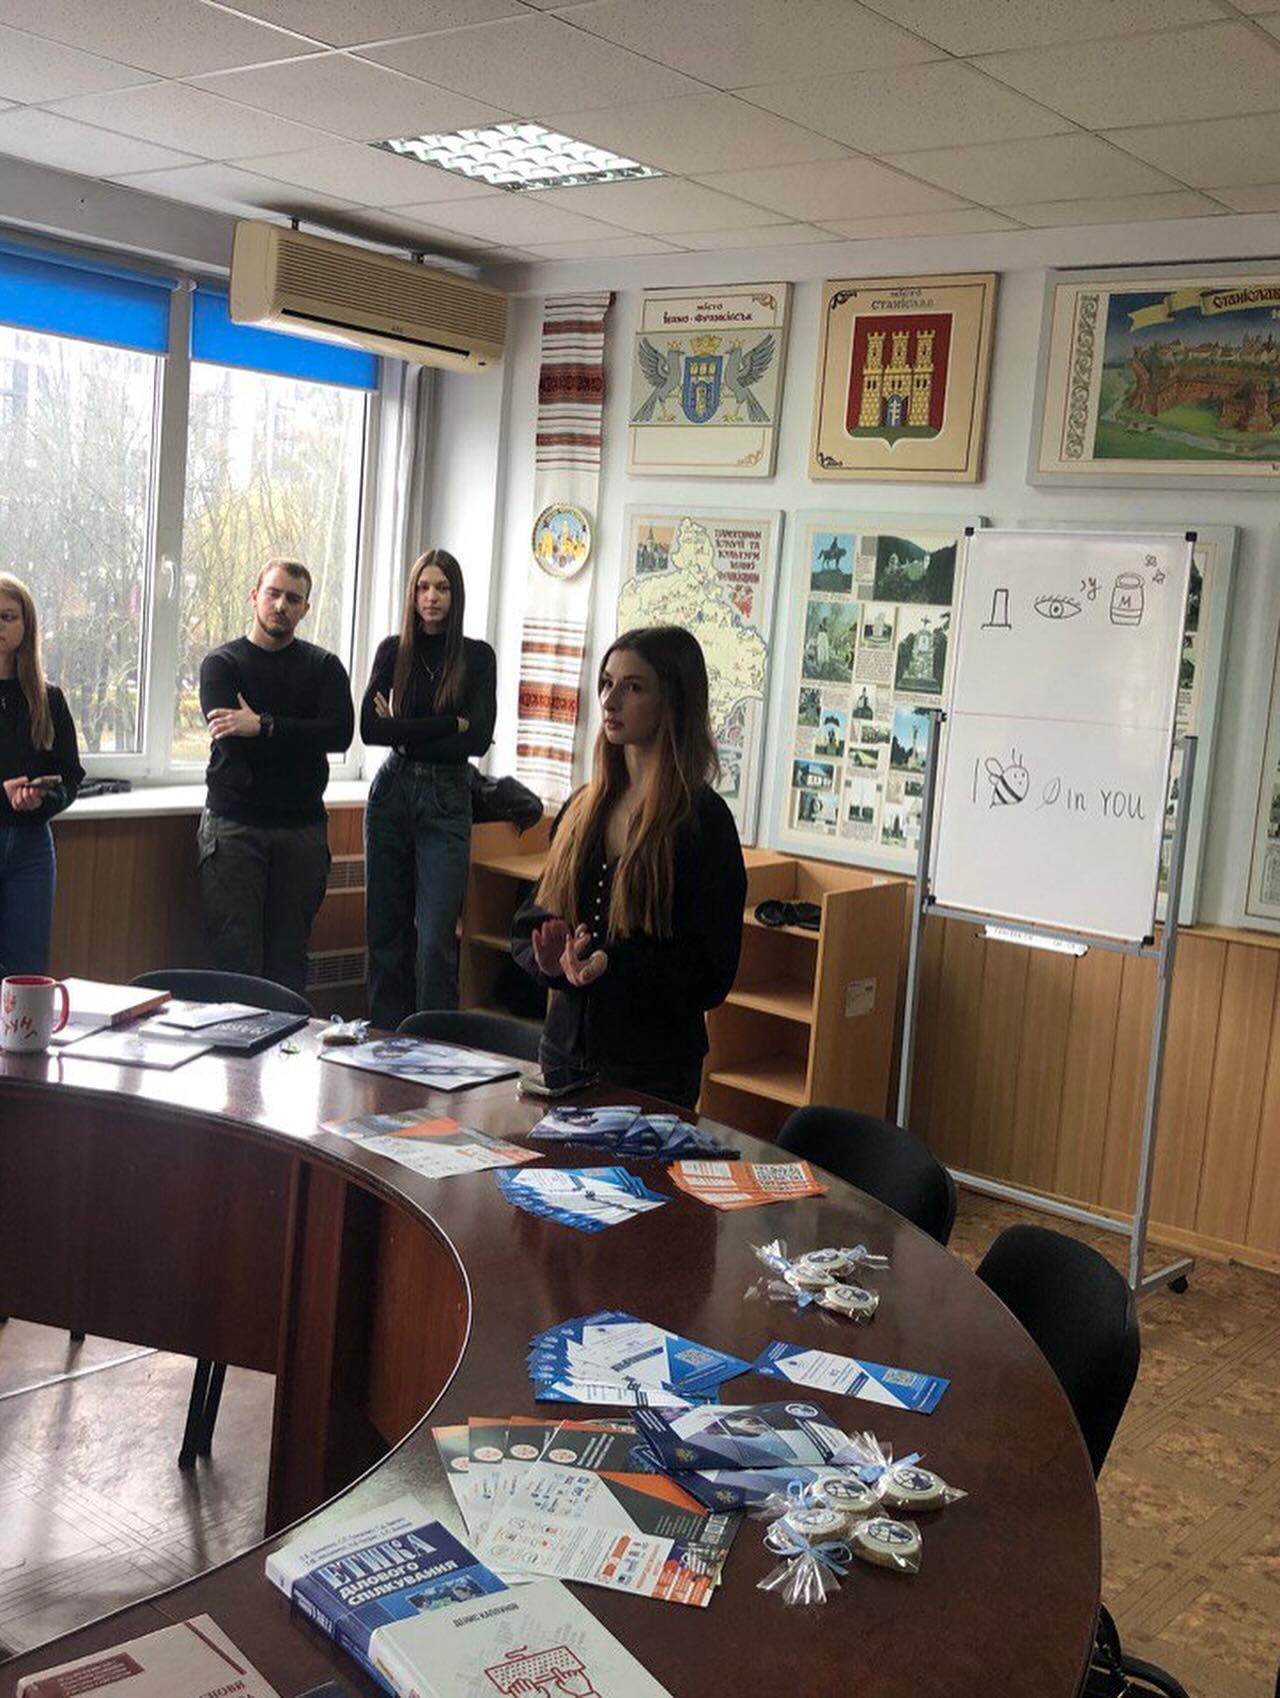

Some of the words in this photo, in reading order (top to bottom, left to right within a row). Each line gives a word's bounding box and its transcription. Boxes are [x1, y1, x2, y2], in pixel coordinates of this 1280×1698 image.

[318, 1534, 437, 1590] ЕТИКА
[340, 1561, 419, 1600] ДІЛОВОГО
[348, 1560, 459, 1606] СПІЛКУВАННЯ
